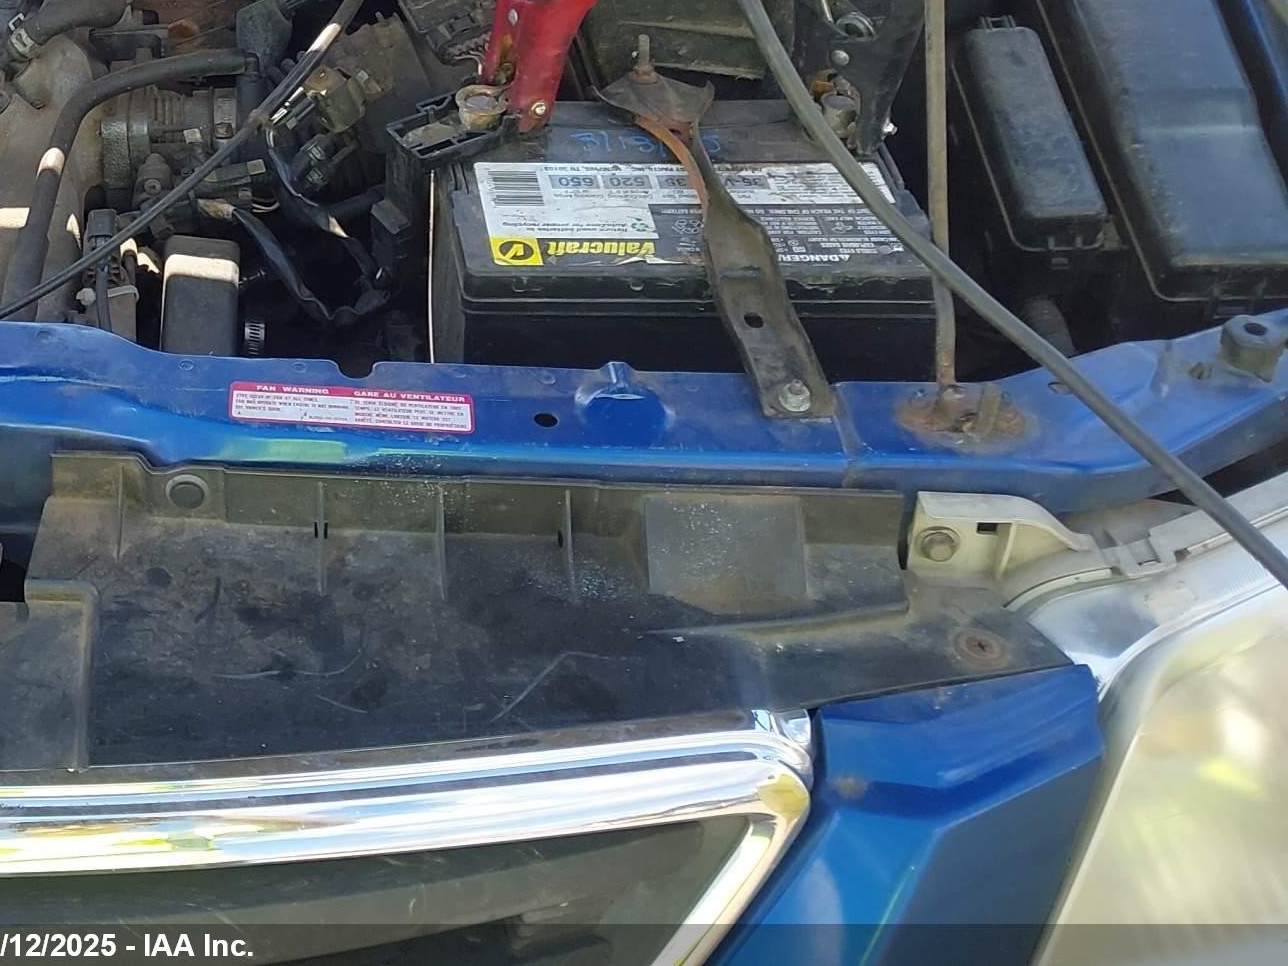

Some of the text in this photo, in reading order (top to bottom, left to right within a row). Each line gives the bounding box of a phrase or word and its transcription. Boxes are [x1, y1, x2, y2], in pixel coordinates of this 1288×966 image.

[559, 177, 594, 186] 650
[609, 177, 645, 186] 520
[665, 178, 686, 186] 35
[546, 241, 656, 257] Valucraft
[282, 386, 329, 394] WARNING
[400, 394, 465, 402] VENTILATEUR
